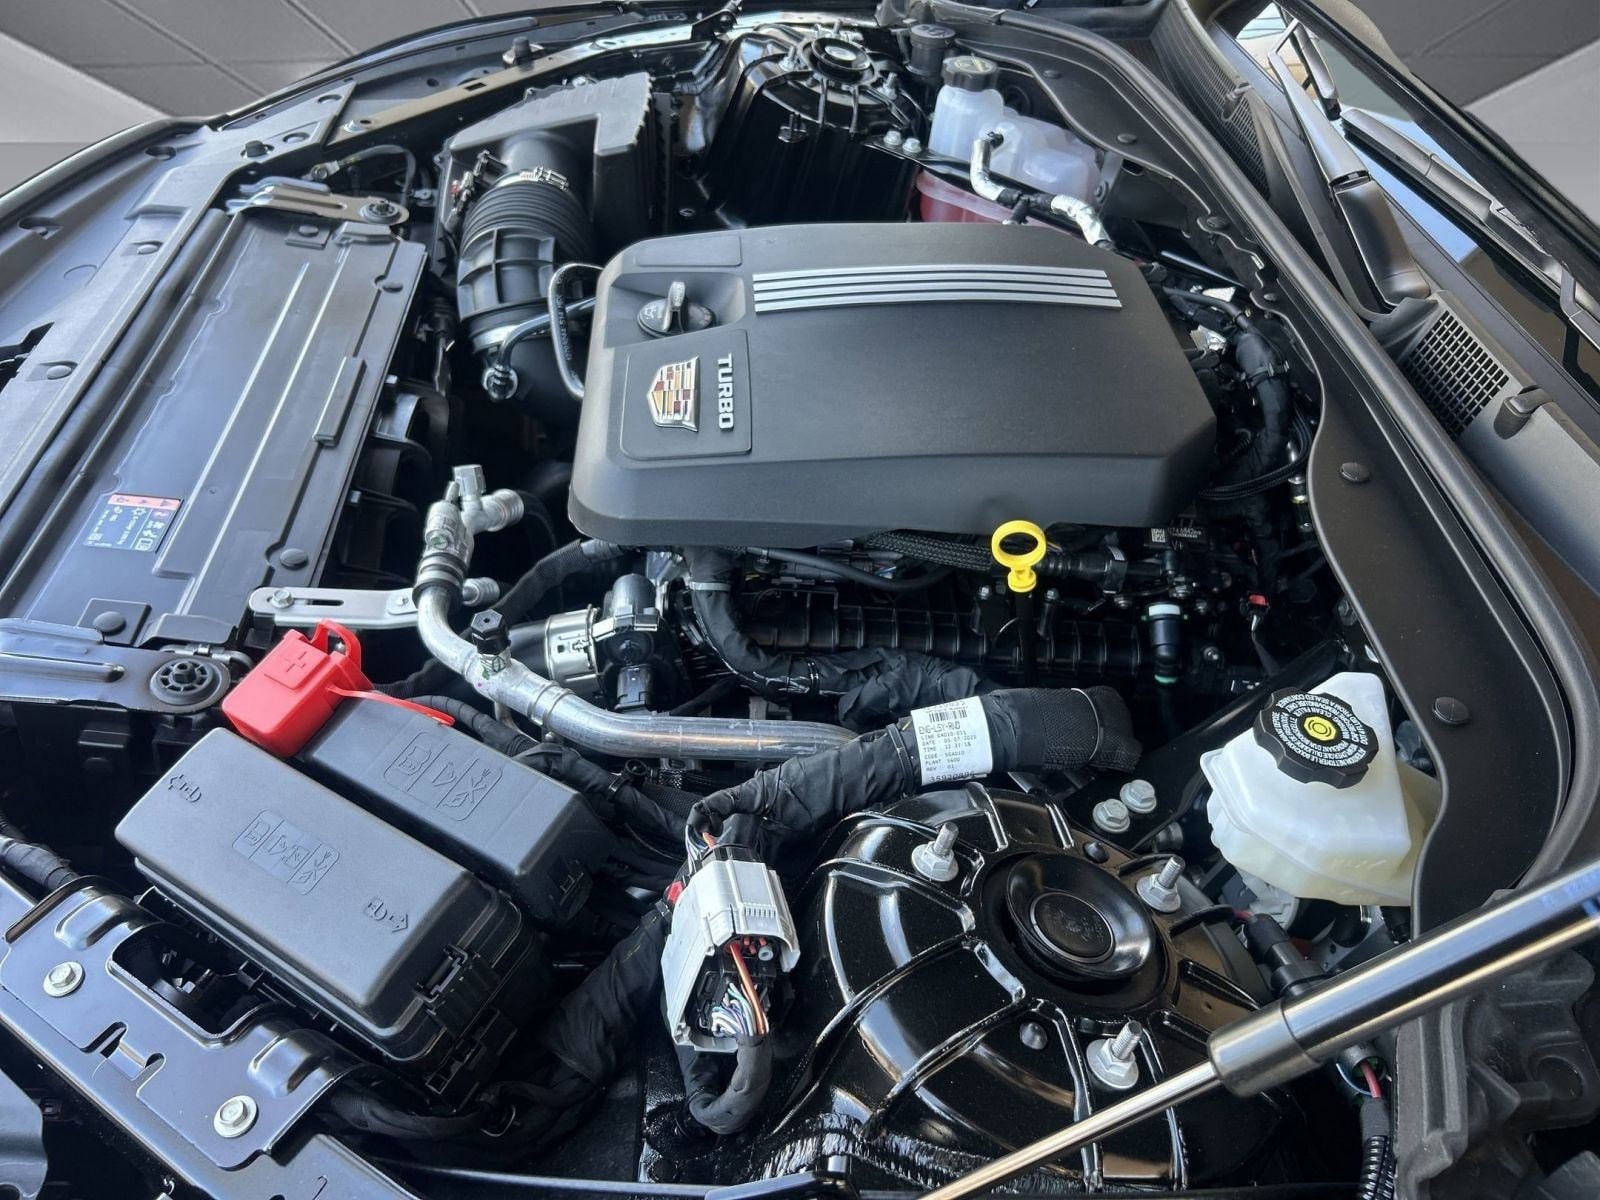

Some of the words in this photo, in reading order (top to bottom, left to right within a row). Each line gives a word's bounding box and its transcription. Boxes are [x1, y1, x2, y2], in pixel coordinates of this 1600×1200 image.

[718, 352, 734, 429] TURBO
[1292, 707, 1311, 717] FILLER
[1310, 707, 1332, 718] CLEAN
[1333, 703, 1352, 717] FROM
